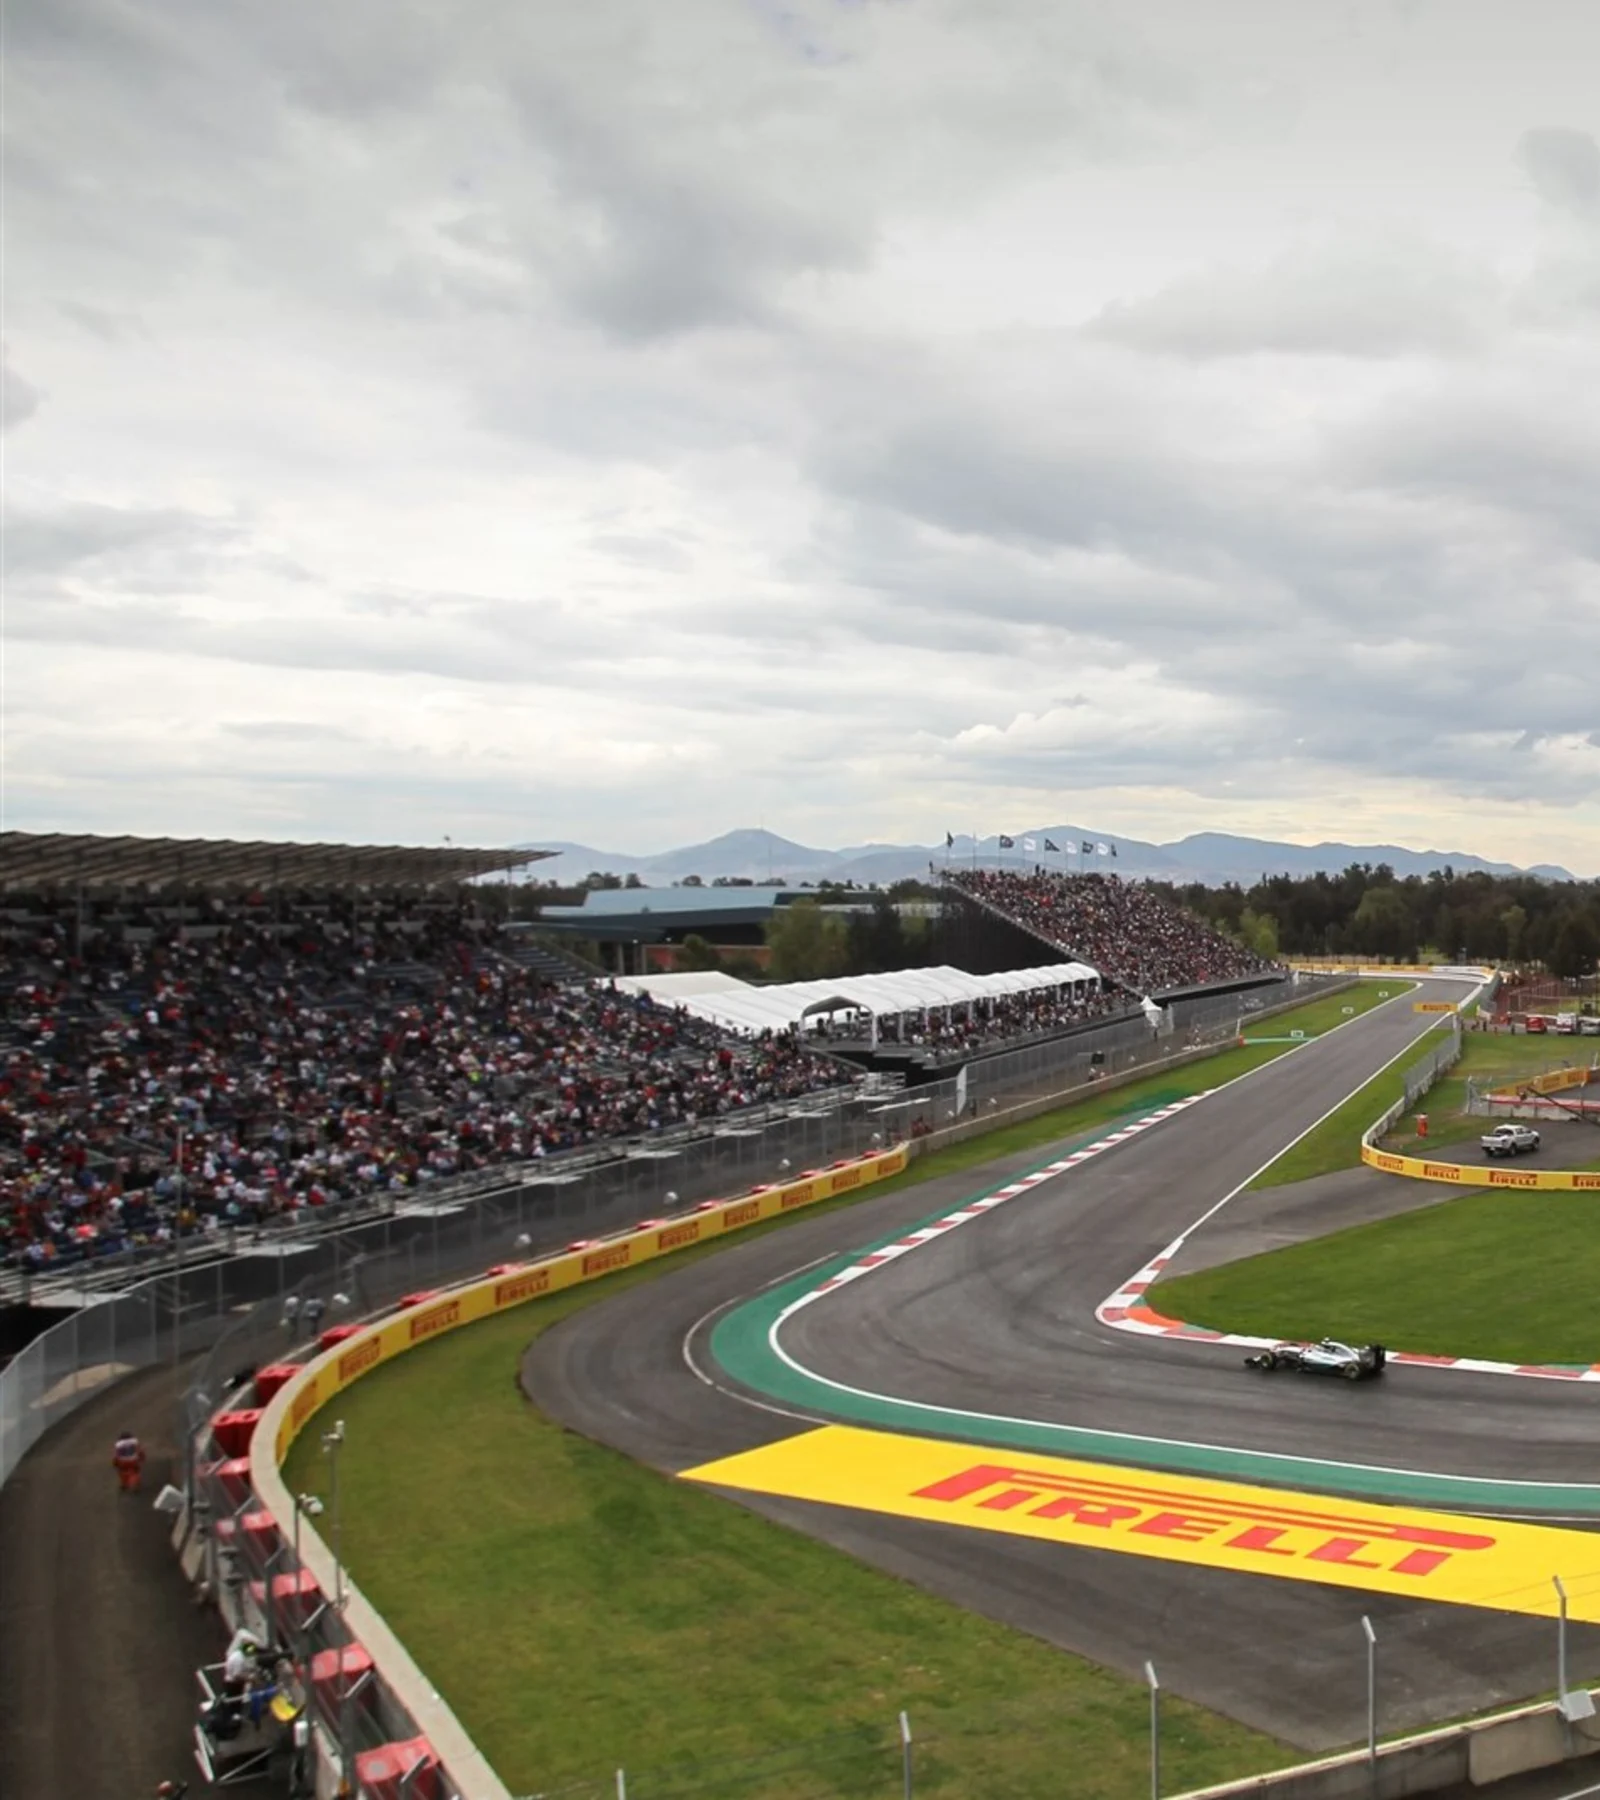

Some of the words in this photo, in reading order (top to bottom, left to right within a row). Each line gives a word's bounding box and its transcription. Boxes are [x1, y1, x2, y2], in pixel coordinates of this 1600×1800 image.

[1423, 1164, 1460, 1180] PIRELLI
[1489, 1171, 1538, 1186] PIRELLI
[583, 1243, 630, 1276] PIRELLI
[495, 1269, 549, 1306] PIRELLI
[411, 1300, 459, 1340] PIRELLI
[909, 1464, 1496, 1576] PIRELLI
